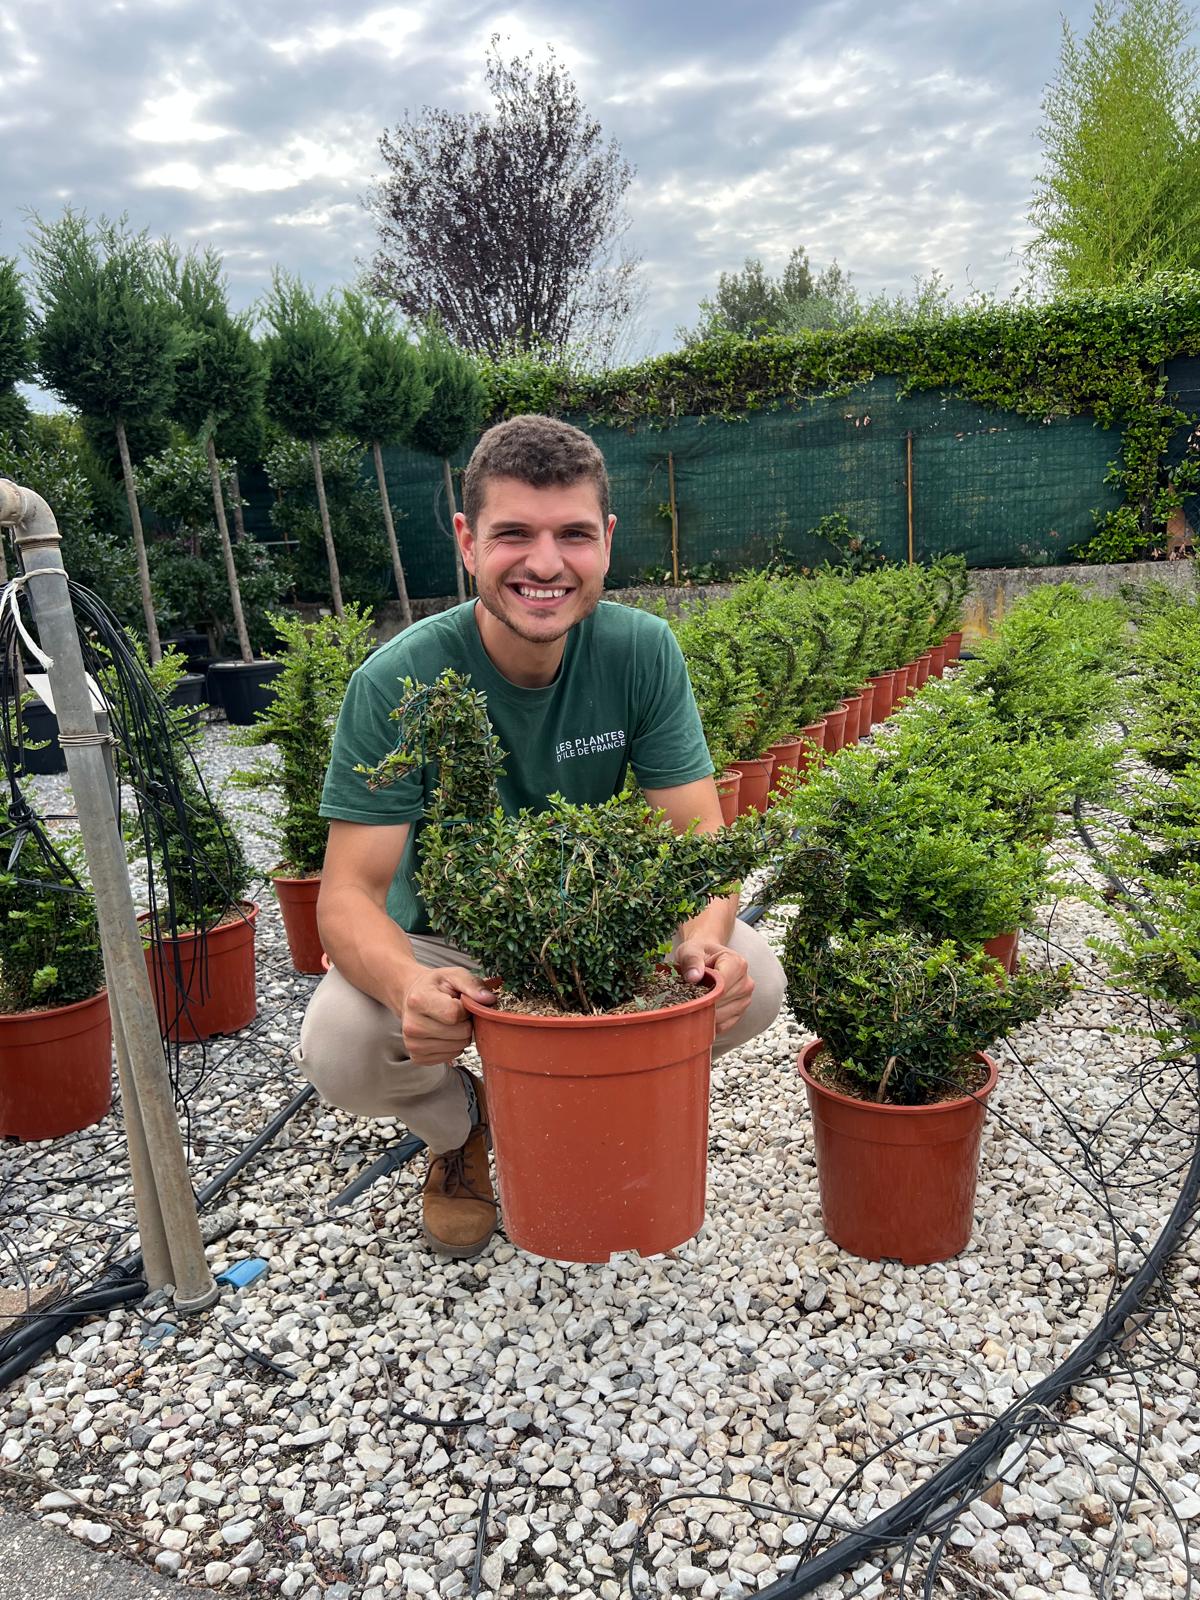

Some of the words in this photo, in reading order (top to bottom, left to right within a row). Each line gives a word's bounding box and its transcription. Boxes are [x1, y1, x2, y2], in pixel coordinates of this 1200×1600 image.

[555, 741, 572, 754] LES
[575, 730, 625, 748] PLANTES
[577, 747, 590, 756] DE
[590, 739, 627, 754] FRANCE
